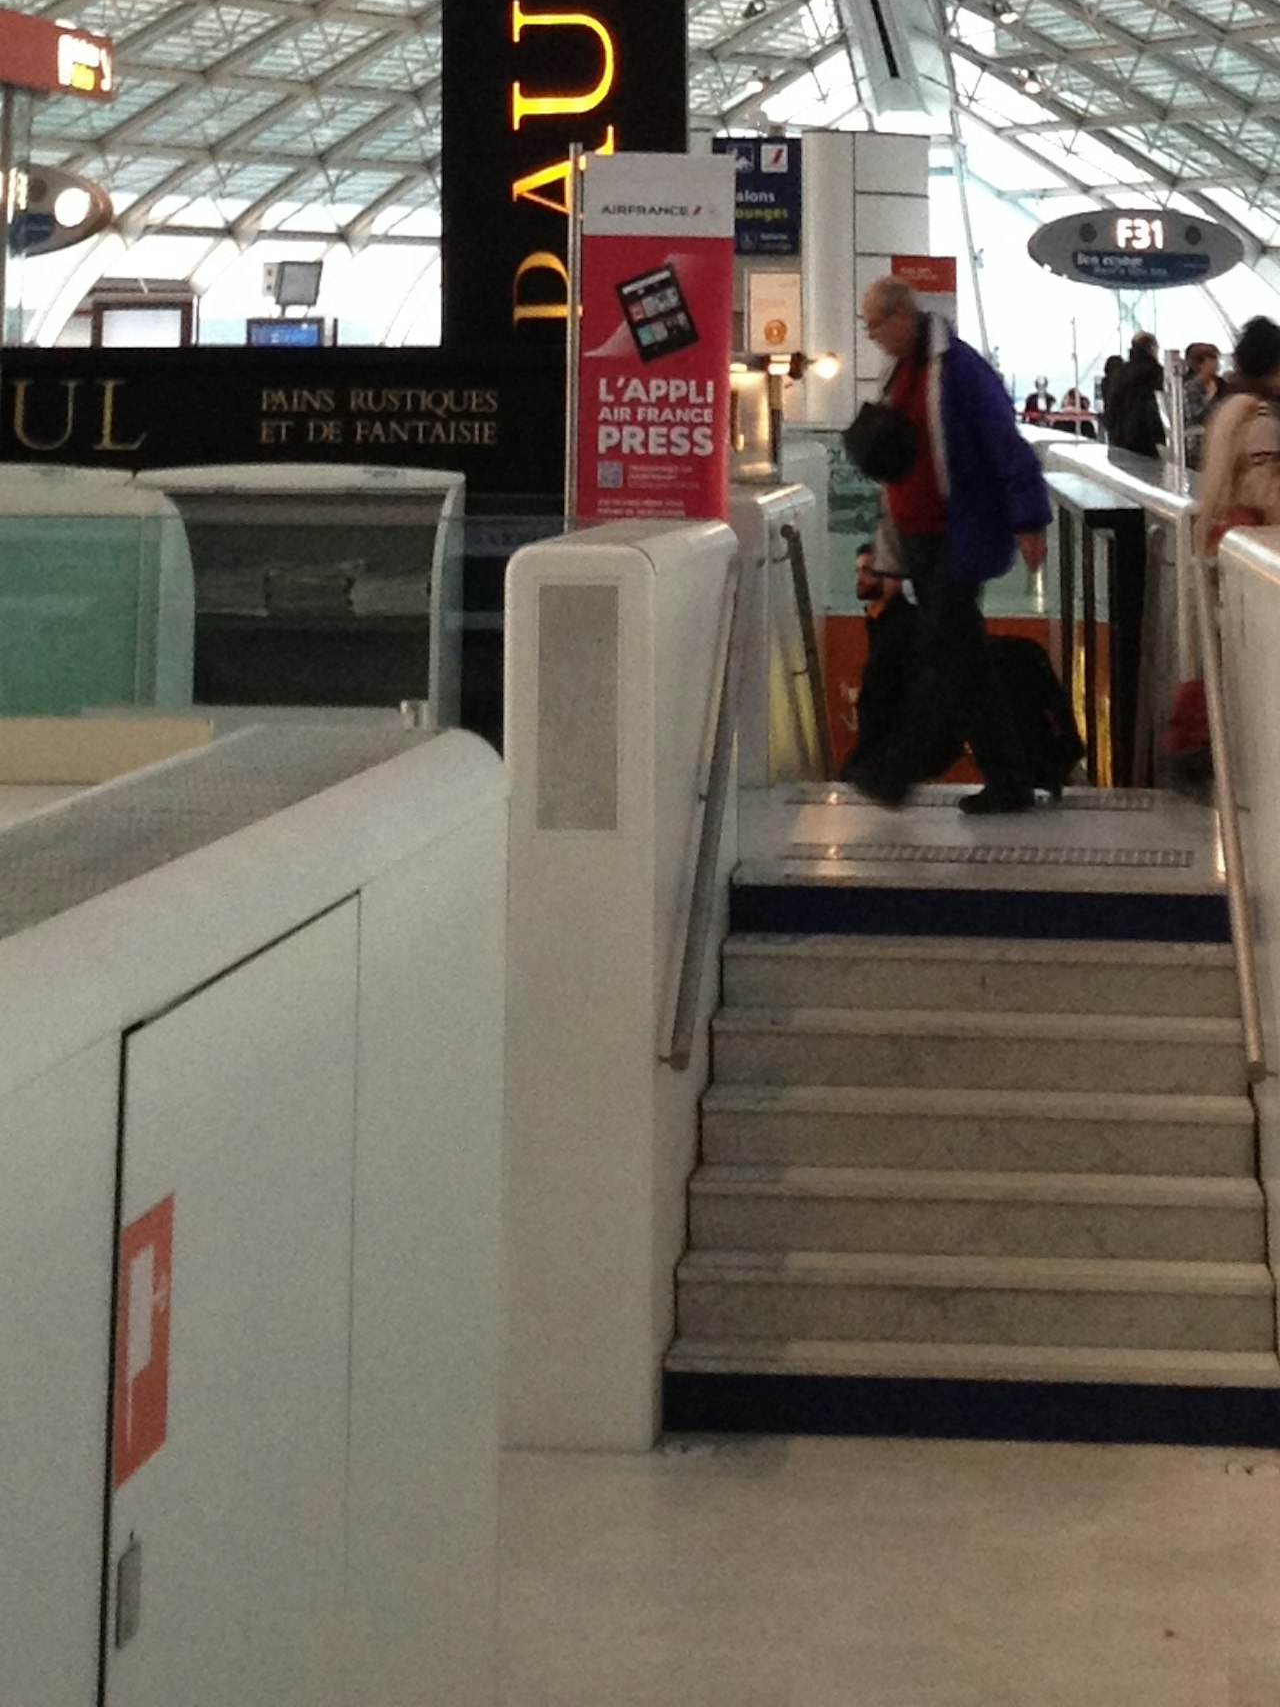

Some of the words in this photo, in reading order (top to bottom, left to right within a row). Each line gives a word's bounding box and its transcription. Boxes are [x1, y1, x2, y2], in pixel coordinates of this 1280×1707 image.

[735, 189, 776, 203] alons
[602, 203, 689, 216] AIRFRANCE
[735, 207, 789, 222] ounges
[1115, 218, 1165, 250] F31
[599, 375, 714, 404] L'APPLI
[261, 388, 336, 412] PAINS
[350, 388, 499, 418] RUSTIQUES
[598, 406, 632, 422] AIR
[636, 407, 714, 423] FRANCE
[261, 420, 294, 444] ET
[308, 420, 342, 444] DE
[355, 420, 498, 445] FANTAISIE
[598, 425, 714, 457] PRESS
